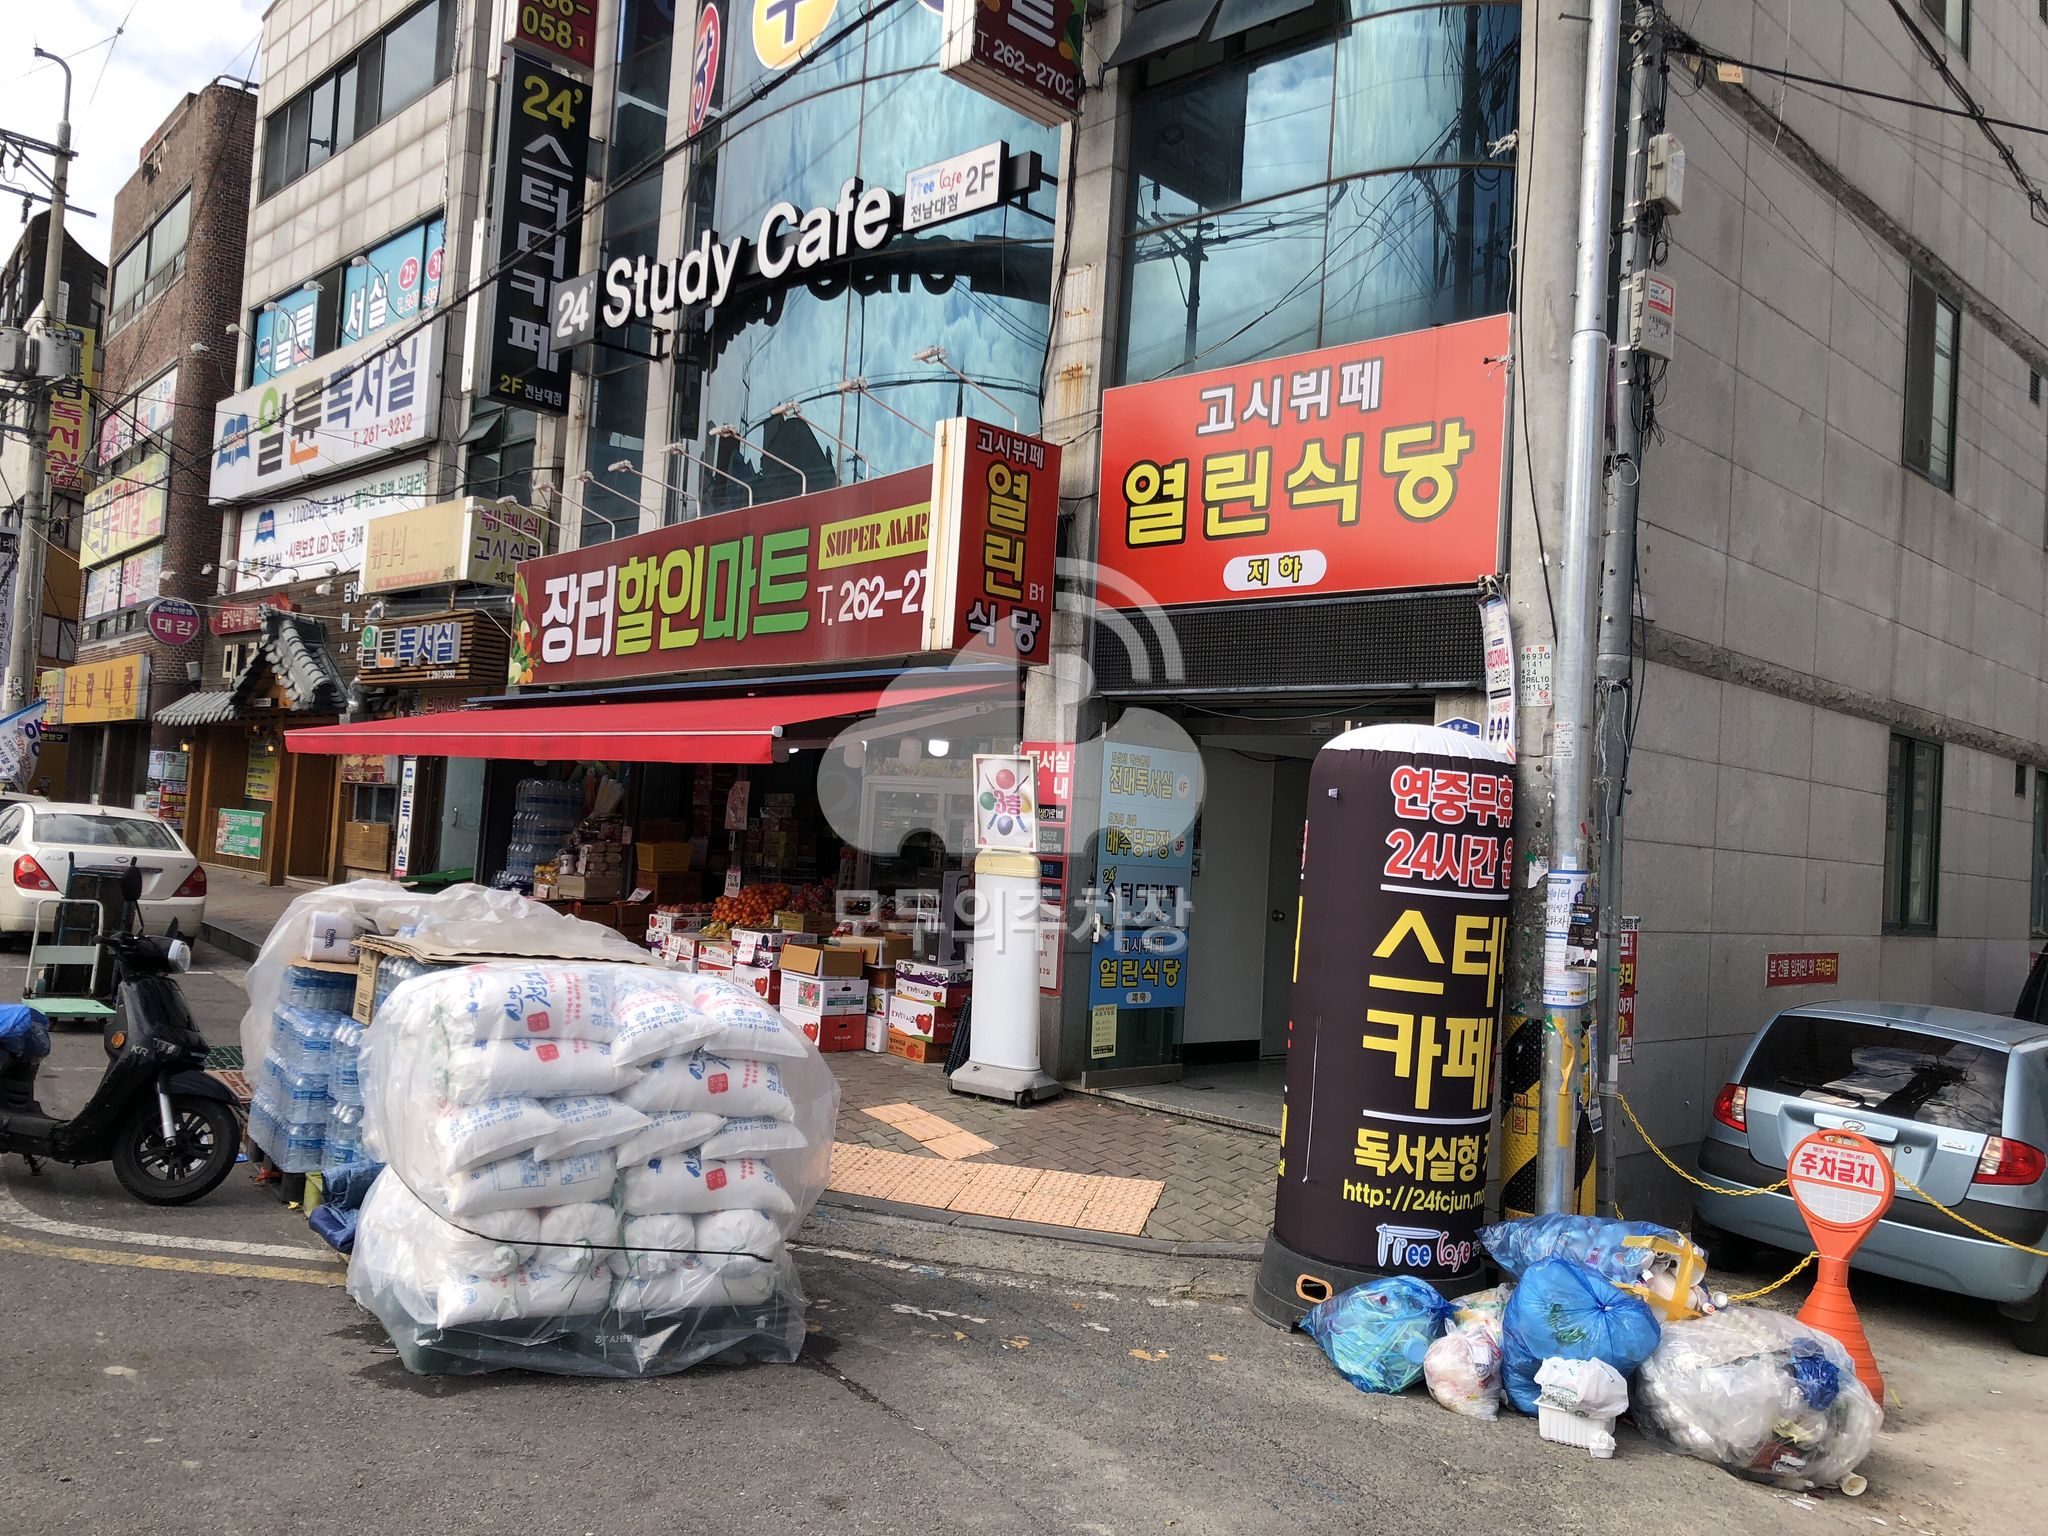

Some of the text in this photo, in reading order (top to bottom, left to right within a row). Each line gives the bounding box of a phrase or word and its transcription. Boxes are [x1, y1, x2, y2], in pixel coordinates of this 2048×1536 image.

[976, 30, 1076, 101] T. 262-2702
[965, 160, 996, 198] 2F
[910, 192, 959, 223] 전남대점
[508, 133, 574, 372] 스터디카페
[602, 229, 743, 328] Study
[757, 176, 892, 279] Cafe
[500, 374, 523, 395] 2F
[524, 384, 562, 408] 전남대점
[1197, 358, 1383, 436] 고시뷔페
[258, 337, 419, 477] 일류독서실
[363, 412, 413, 445] 261-3232
[976, 428, 1045, 469] 고시뷔페
[1124, 420, 1473, 546] 열린식당
[317, 534, 329, 555] LED
[826, 524, 881, 559] SUPER
[984, 462, 1029, 600] 열린
[1247, 556, 1303, 585] 지하
[541, 527, 810, 664] 장터할인마트
[818, 585, 833, 626] T.
[1029, 583, 1046, 603] B1
[157, 618, 193, 636] 대감
[361, 622, 456, 668] 일류독서실
[968, 601, 1041, 652] 식당
[1109, 764, 1174, 800] 전대독서실
[1105, 825, 1171, 859] 배추당구장
[1174, 840, 1185, 852] 3F
[1383, 828, 1499, 889] 24시간
[1119, 936, 1165, 954] 고시뷔페
[1099, 957, 1181, 989] 열린식당
[1362, 1009, 1494, 1111] 카페
[1353, 1127, 1480, 1183] 독서실형
[1800, 1153, 1876, 1189] 주차금지
[1376, 1223, 1471, 1273] Free Cafe
